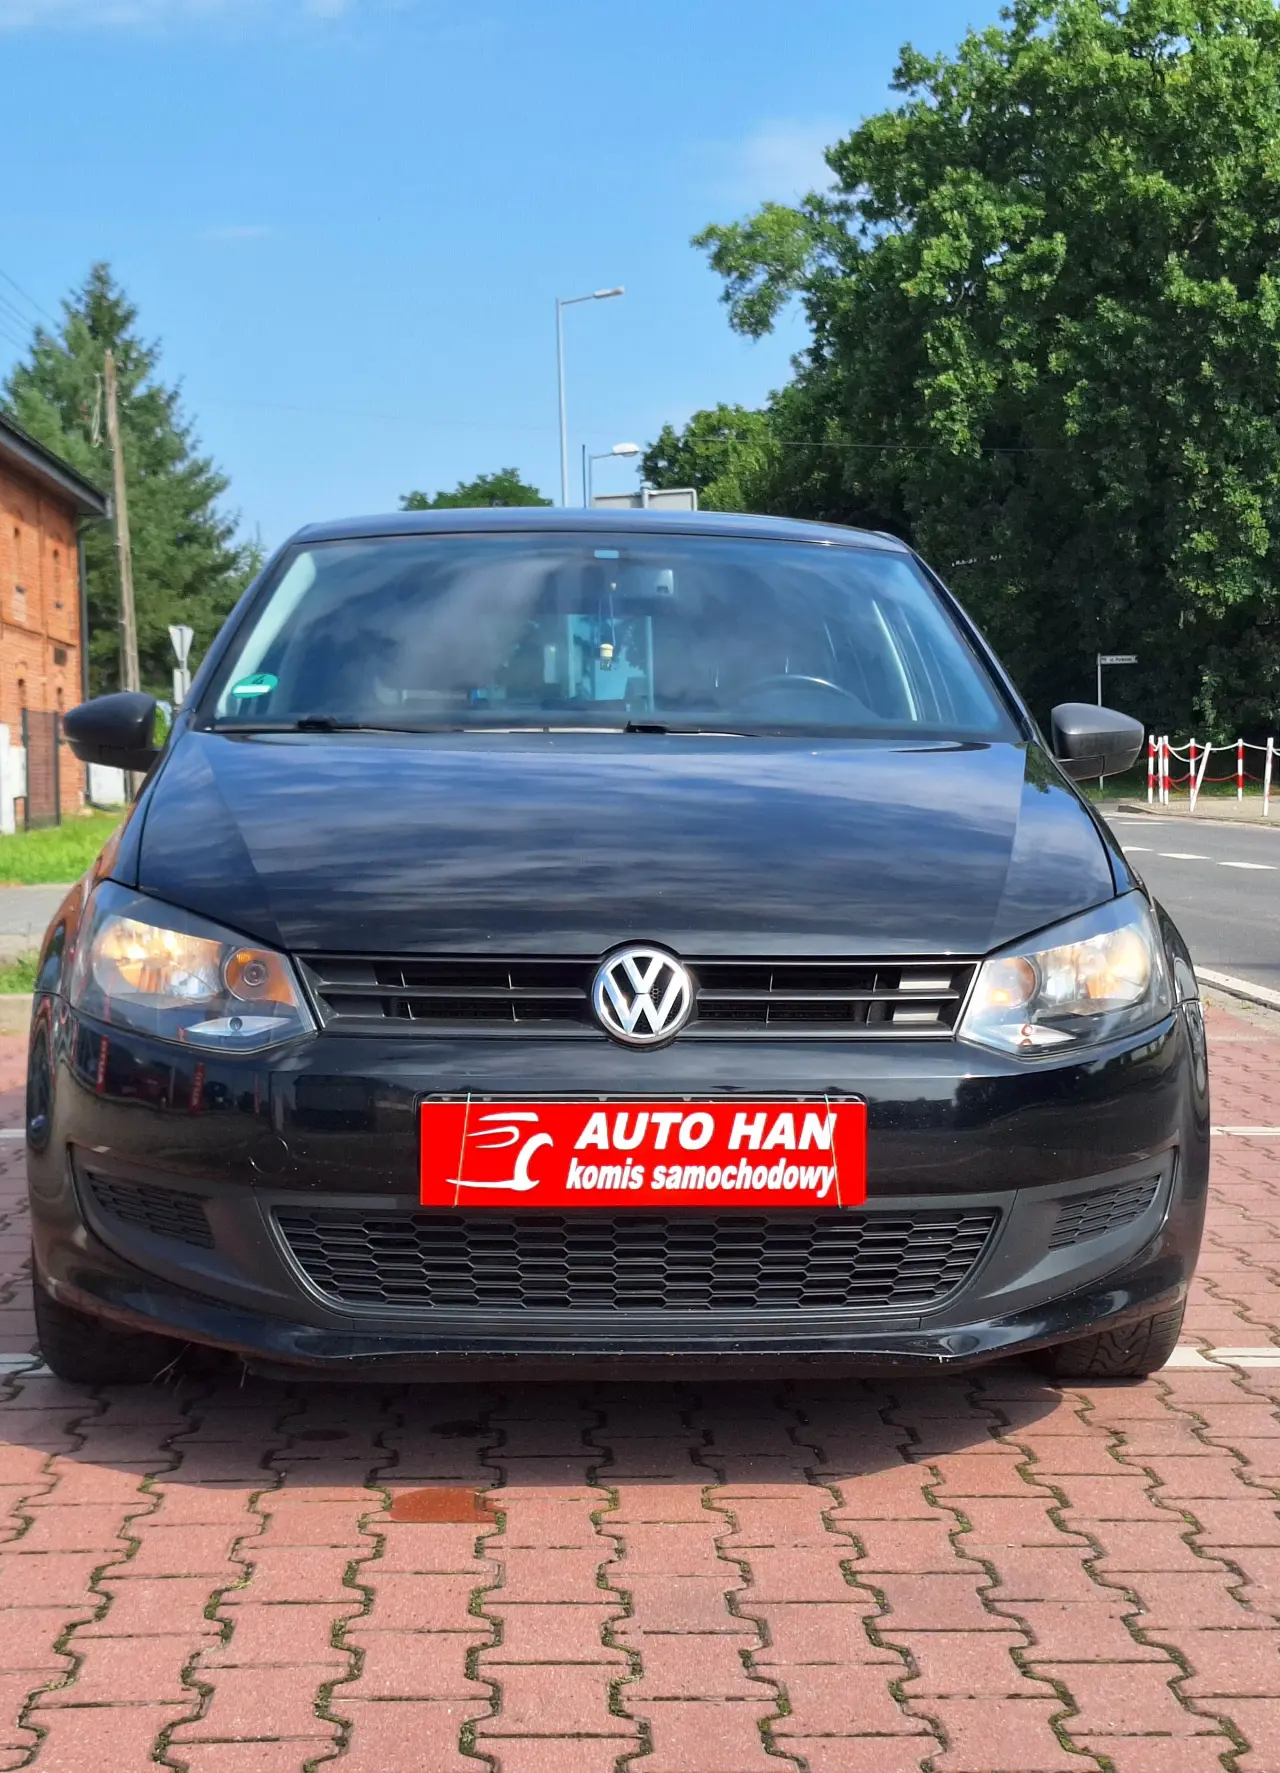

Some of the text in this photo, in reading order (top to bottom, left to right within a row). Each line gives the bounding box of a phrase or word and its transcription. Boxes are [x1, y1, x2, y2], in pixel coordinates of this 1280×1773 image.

[573, 1111, 838, 1151] AUTO HAN
[565, 1157, 838, 1198] komis samochodowy
